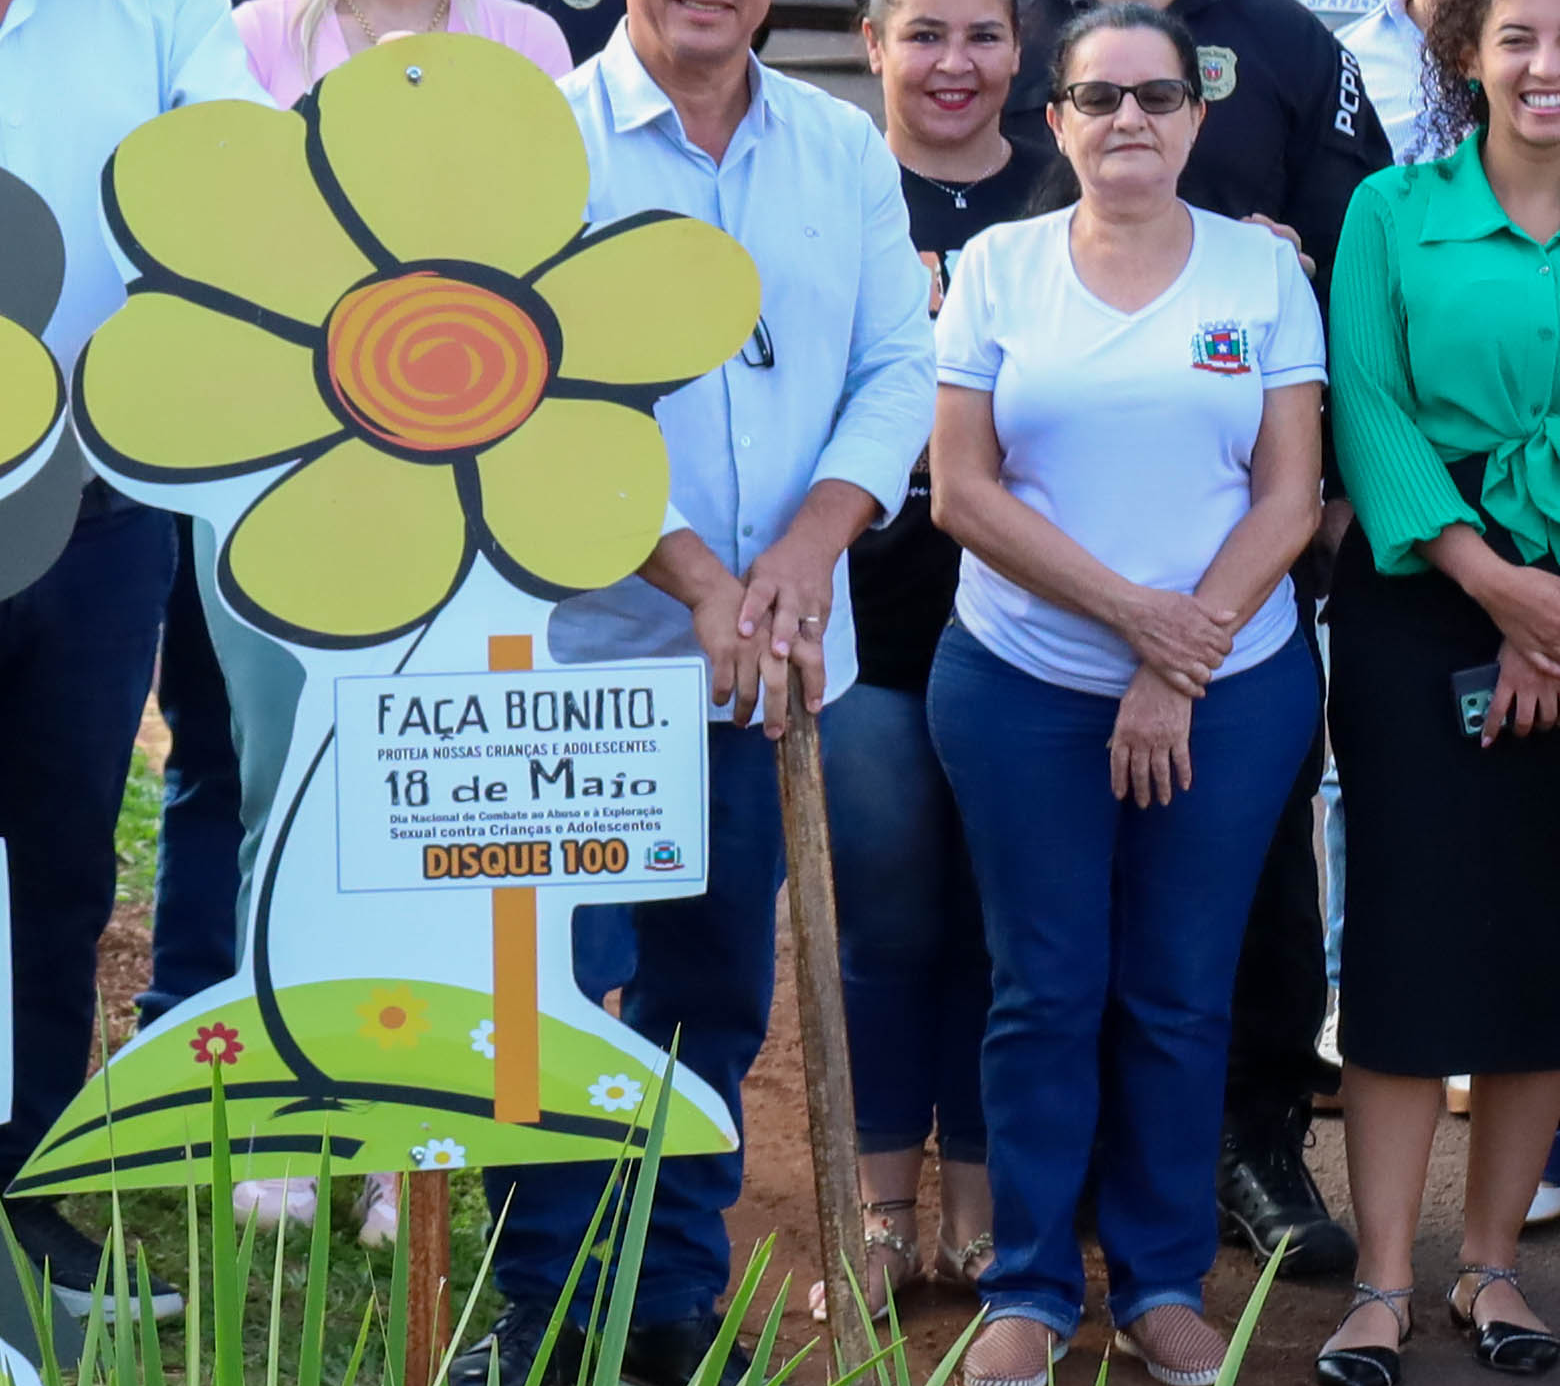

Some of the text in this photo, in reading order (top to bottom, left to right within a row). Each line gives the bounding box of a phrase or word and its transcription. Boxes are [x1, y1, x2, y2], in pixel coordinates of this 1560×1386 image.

[377, 687, 669, 741] FAÇA BONITO.
[377, 740, 661, 762] PROTEJA NOSSAS CRIANÇAS E ADOLESCENTES.
[384, 757, 657, 807] 18 de Maio
[390, 805, 663, 824] Dia Nacional de Combate ao Abuso e à Exploração
[390, 819, 661, 840] Sexual contra Crianças e Adolescentes
[422, 837, 629, 880] DISQUE 100
